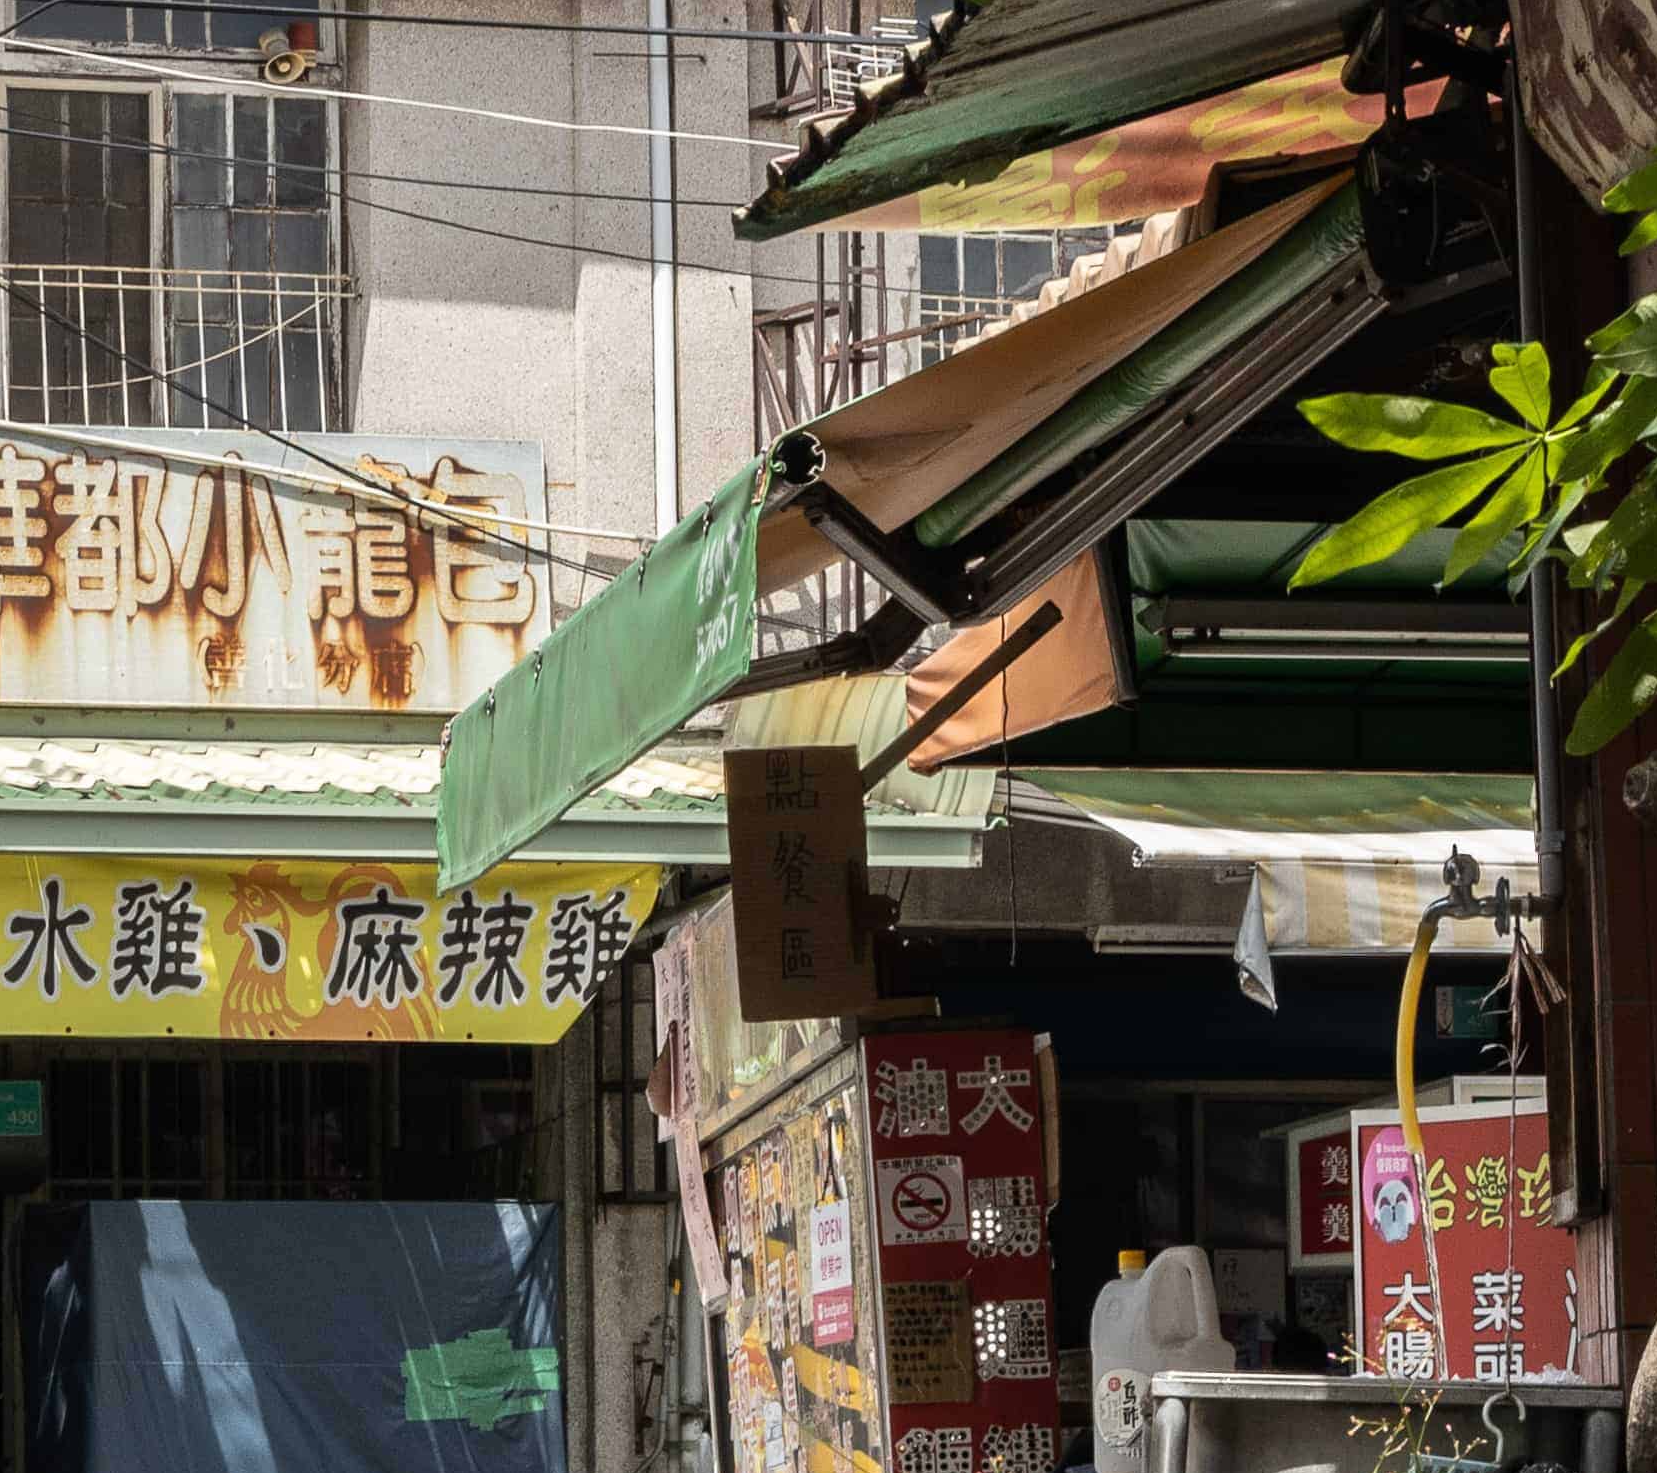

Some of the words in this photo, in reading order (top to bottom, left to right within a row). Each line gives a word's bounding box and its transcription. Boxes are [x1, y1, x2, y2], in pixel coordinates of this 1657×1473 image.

[766, 749, 820, 979] 點餐區
[817, 1217, 843, 1247] OPEN
